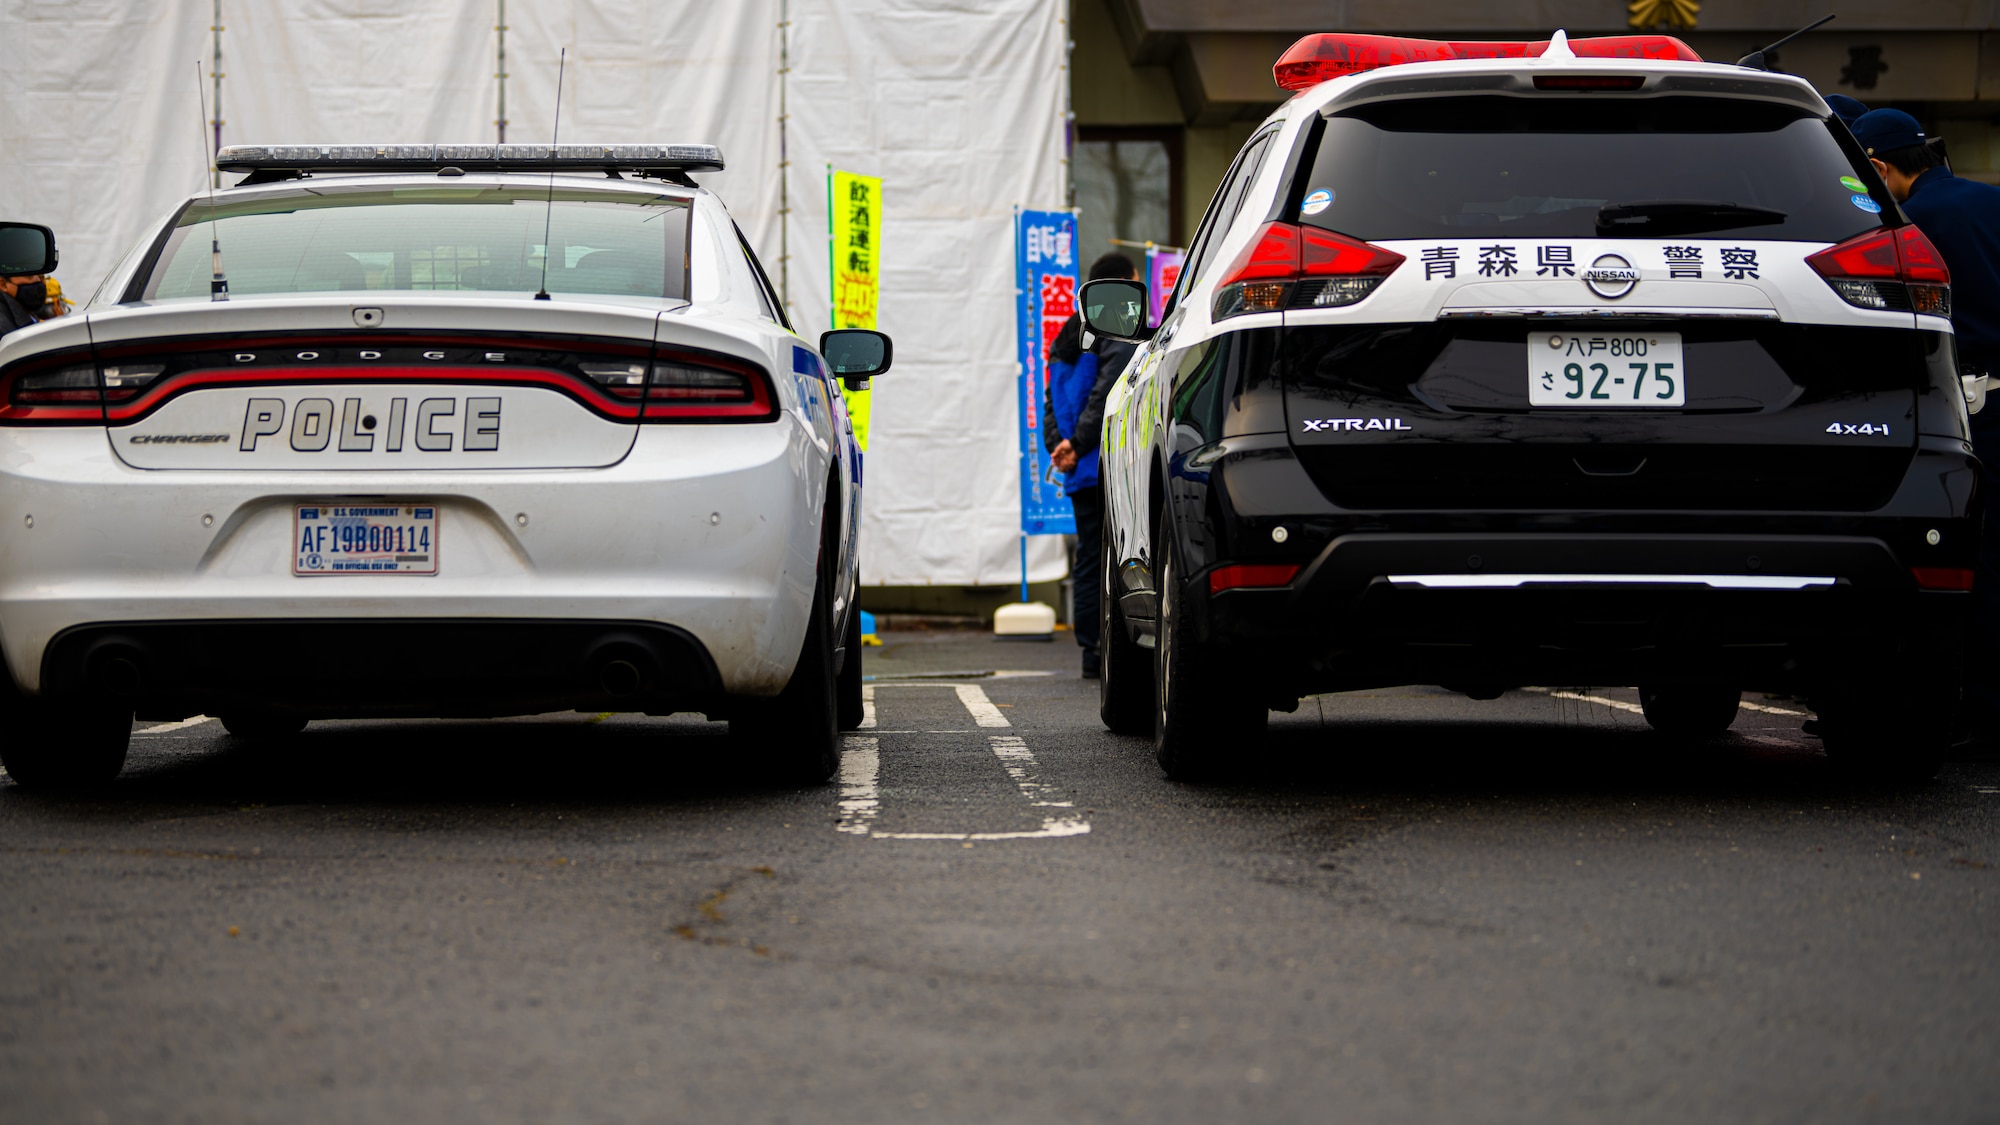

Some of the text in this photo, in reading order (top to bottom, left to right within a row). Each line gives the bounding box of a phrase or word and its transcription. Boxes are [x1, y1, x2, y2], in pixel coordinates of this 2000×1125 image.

[1420, 245, 1761, 280] 青森県 警察
[1587, 270, 1635, 279] NISSAN
[1566, 338, 1647, 357] 八戸800
[235, 351, 507, 362] DODGE
[1541, 362, 1675, 400] さ 92-75
[239, 397, 503, 452] POLICE
[1302, 418, 1412, 432] X-TRAIL
[129, 434, 230, 444] CHARGER
[334, 508, 398, 516] U.S. GOVERNMENT
[301, 525, 430, 553] AF19B00114
